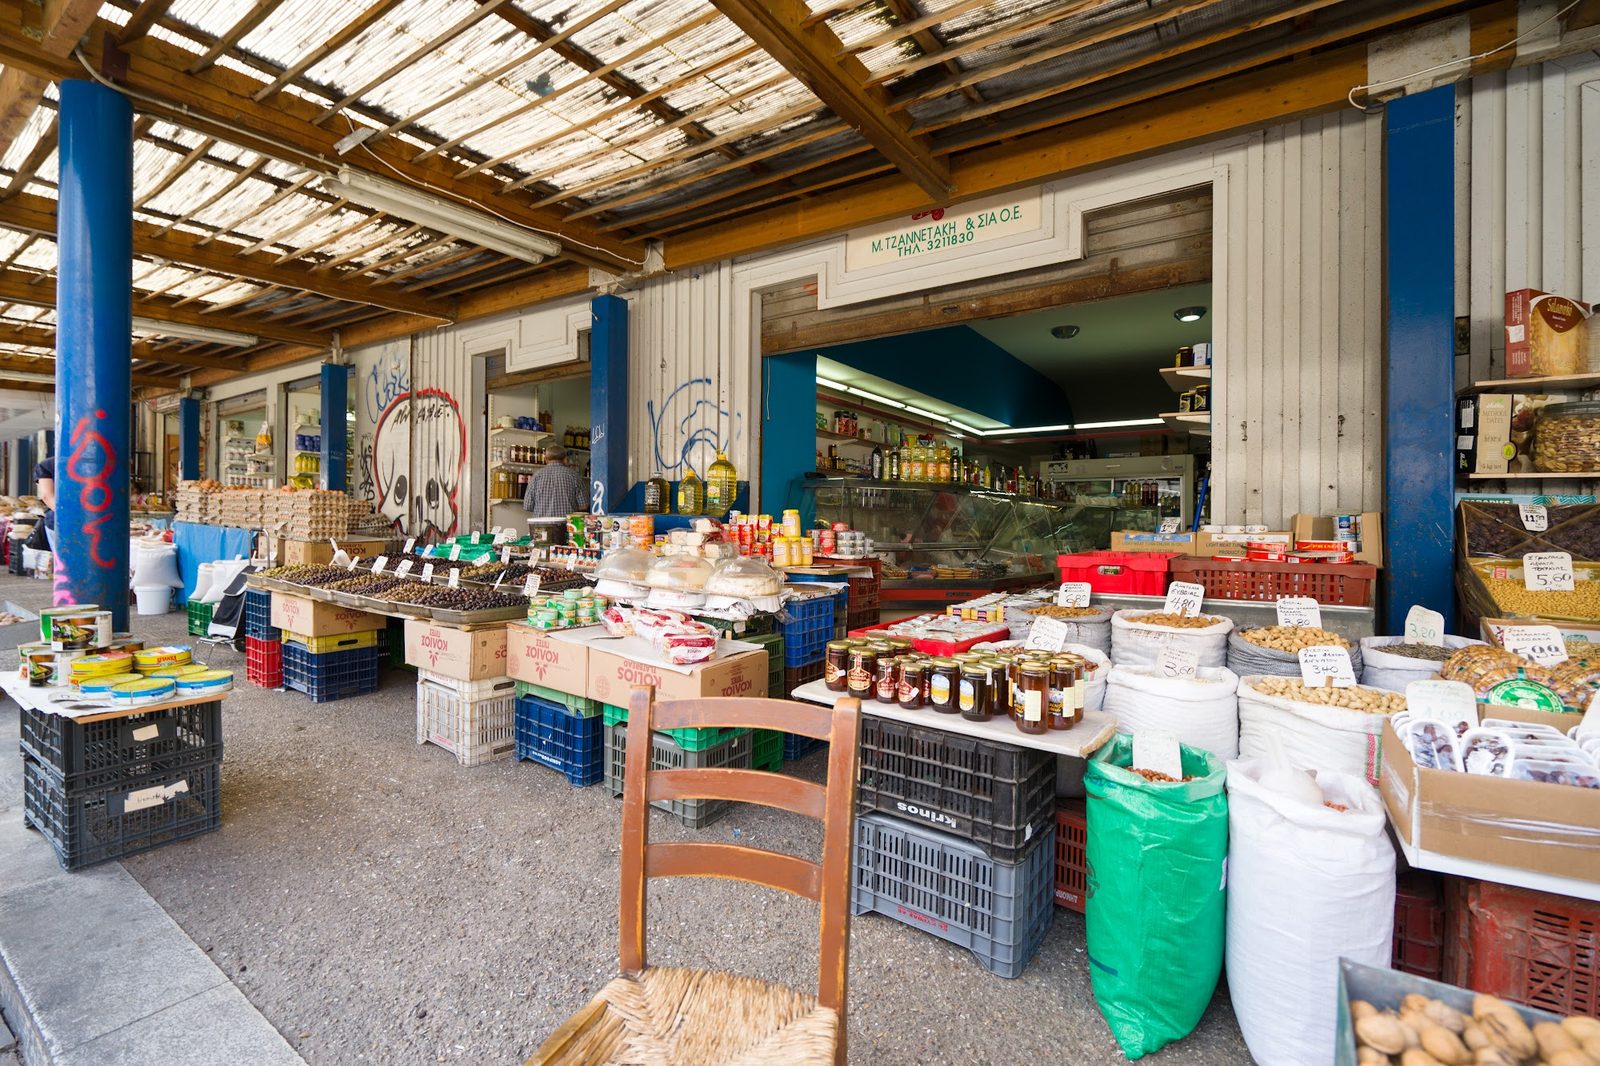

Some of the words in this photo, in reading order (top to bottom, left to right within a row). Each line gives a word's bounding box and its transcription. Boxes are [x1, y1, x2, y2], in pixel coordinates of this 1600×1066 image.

[871, 239, 883, 253] Μ.
[885, 221, 956, 250] ΤΖΑΝΝΕΤΑΚΗ
[965, 217, 975, 231] &
[978, 211, 997, 228] ΣΙΑ
[1000, 205, 1023, 222] Ο.Ε.
[897, 244, 924, 257] ΤΗΛ.
[927, 231, 974, 251] 3211830
[421, 635, 448, 652] ΚΟΛΙΟΣ
[525, 646, 559, 664] ΚΟΛΙΟΣ
[617, 667, 662, 689] KOLIOS
[720, 679, 752, 697] ΚΟΛΙΟΣ
[896, 801, 957, 829] krinos
